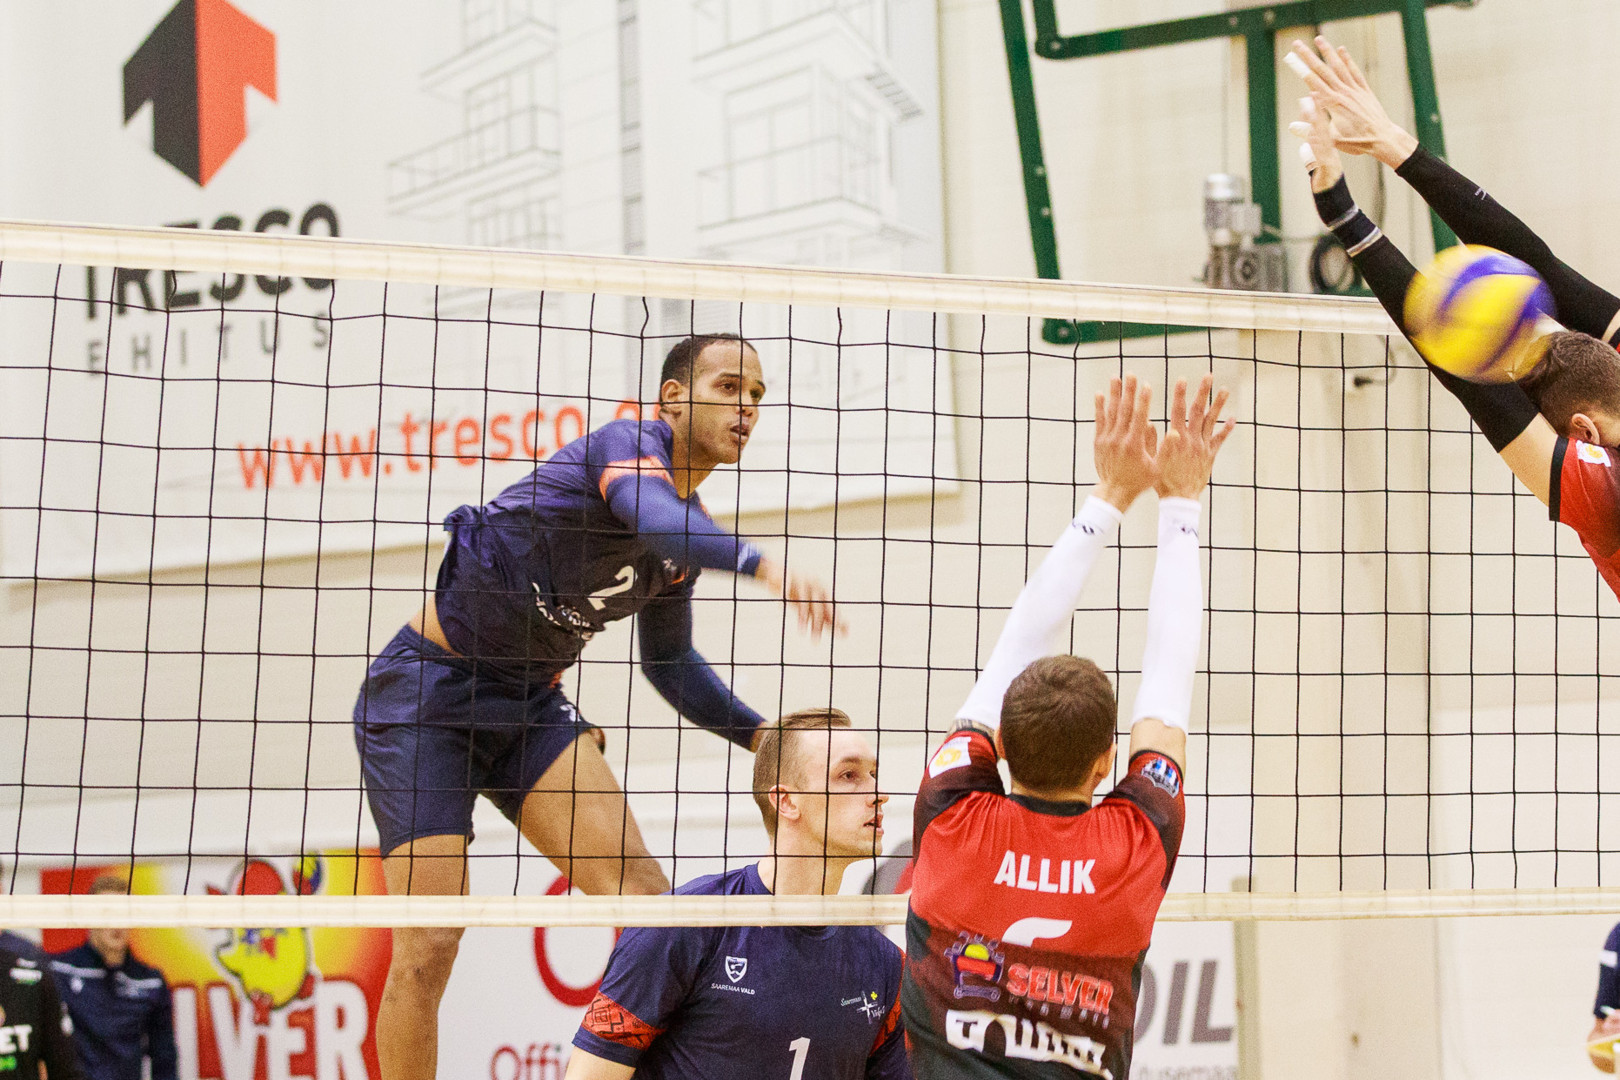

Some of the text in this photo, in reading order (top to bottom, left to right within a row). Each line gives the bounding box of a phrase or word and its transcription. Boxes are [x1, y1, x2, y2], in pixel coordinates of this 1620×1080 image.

[86, 312, 330, 378] EHITUS
[237, 397, 662, 490] www.tresco
[587, 565, 638, 611] 2
[993, 849, 1096, 895] ALLIK
[740, 986, 756, 996] VALD
[1006, 962, 1114, 1015] SELVER
[788, 1036, 811, 1080] 1
